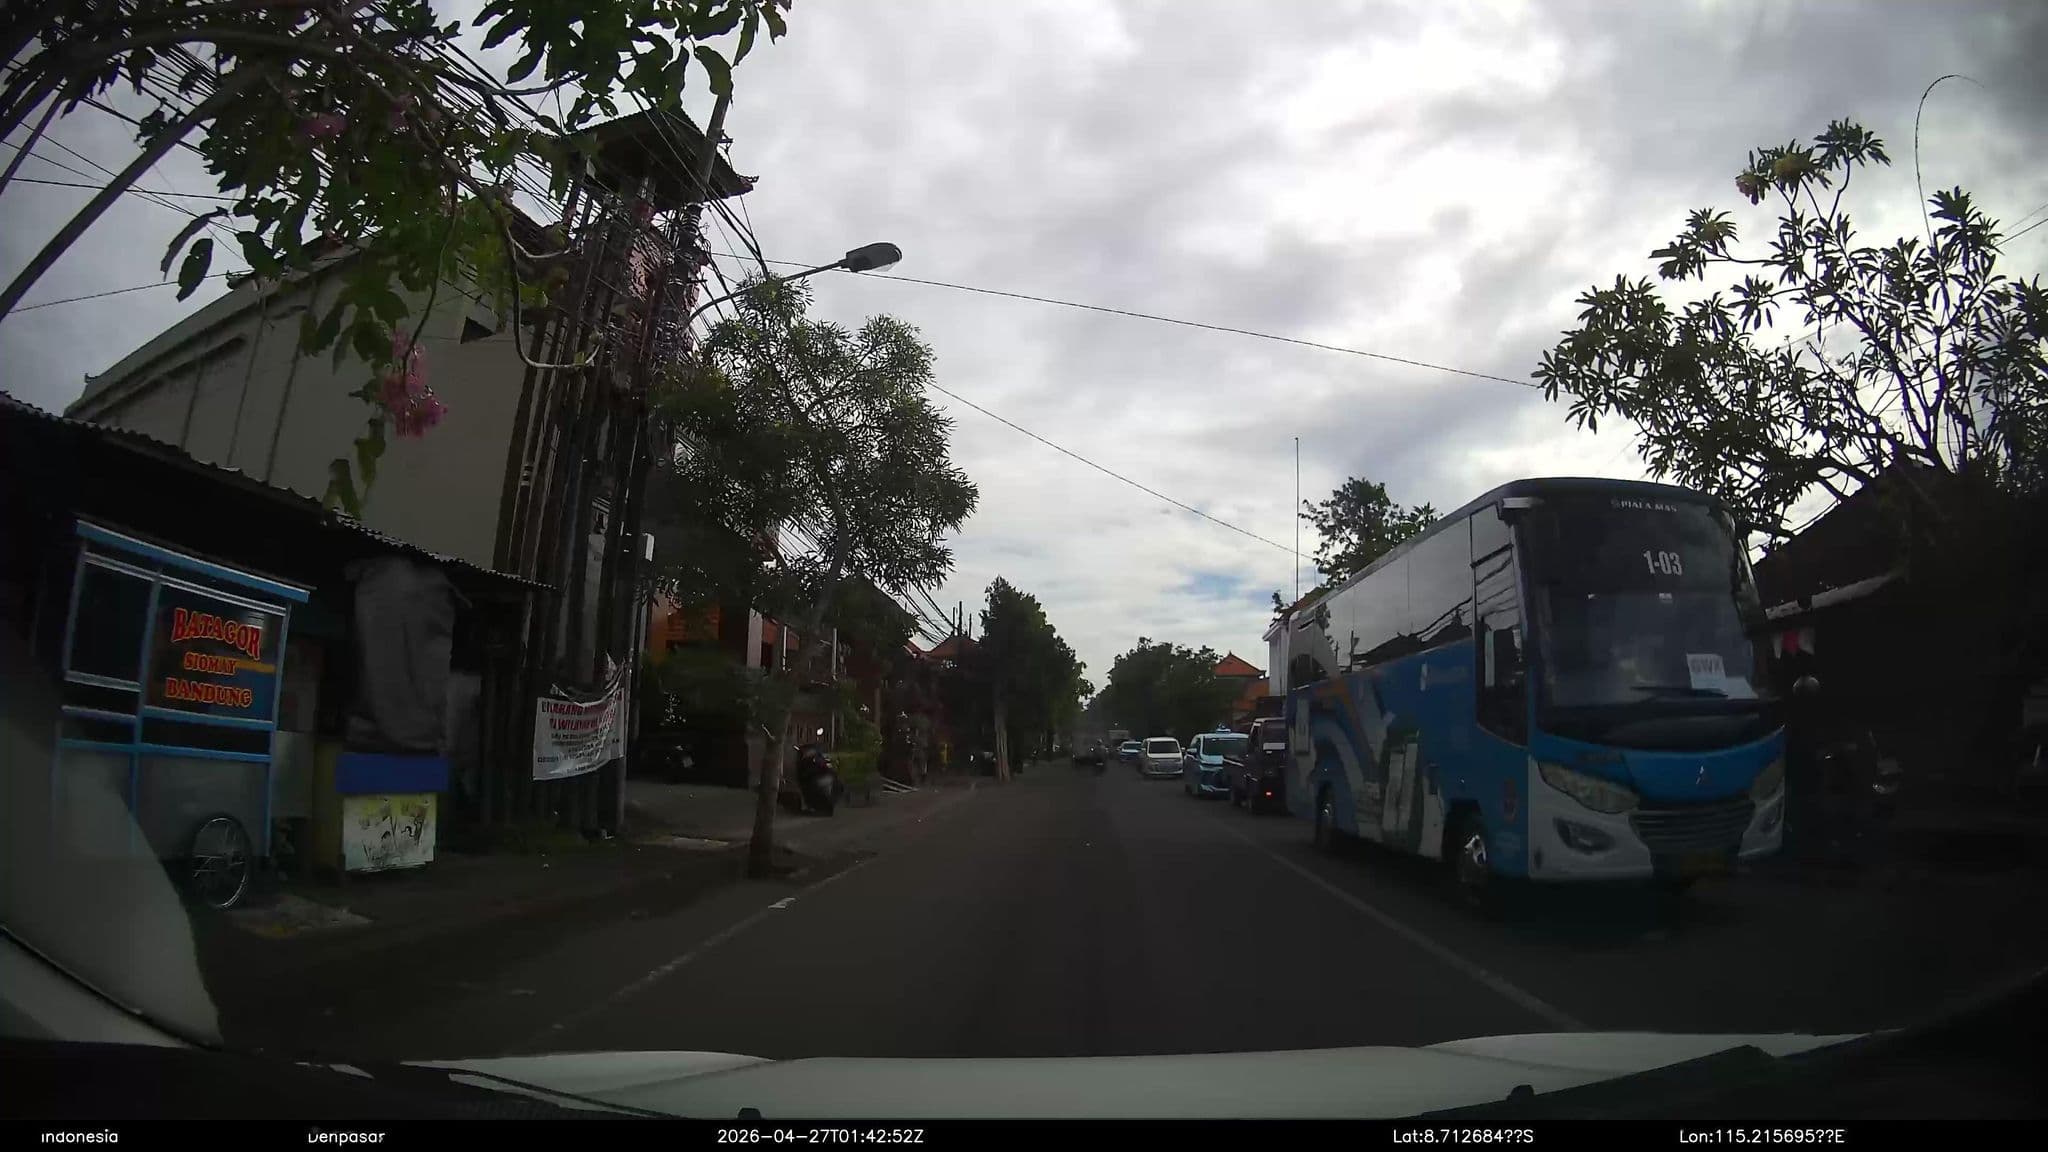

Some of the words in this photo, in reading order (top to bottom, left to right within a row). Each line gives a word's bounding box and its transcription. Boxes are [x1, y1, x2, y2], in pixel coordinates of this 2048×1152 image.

[1643, 549, 1683, 576] 1-03
[172, 608, 261, 661] BATAGOR
[184, 652, 238, 676] SIOMAY
[165, 678, 252, 708] BANDUNG
